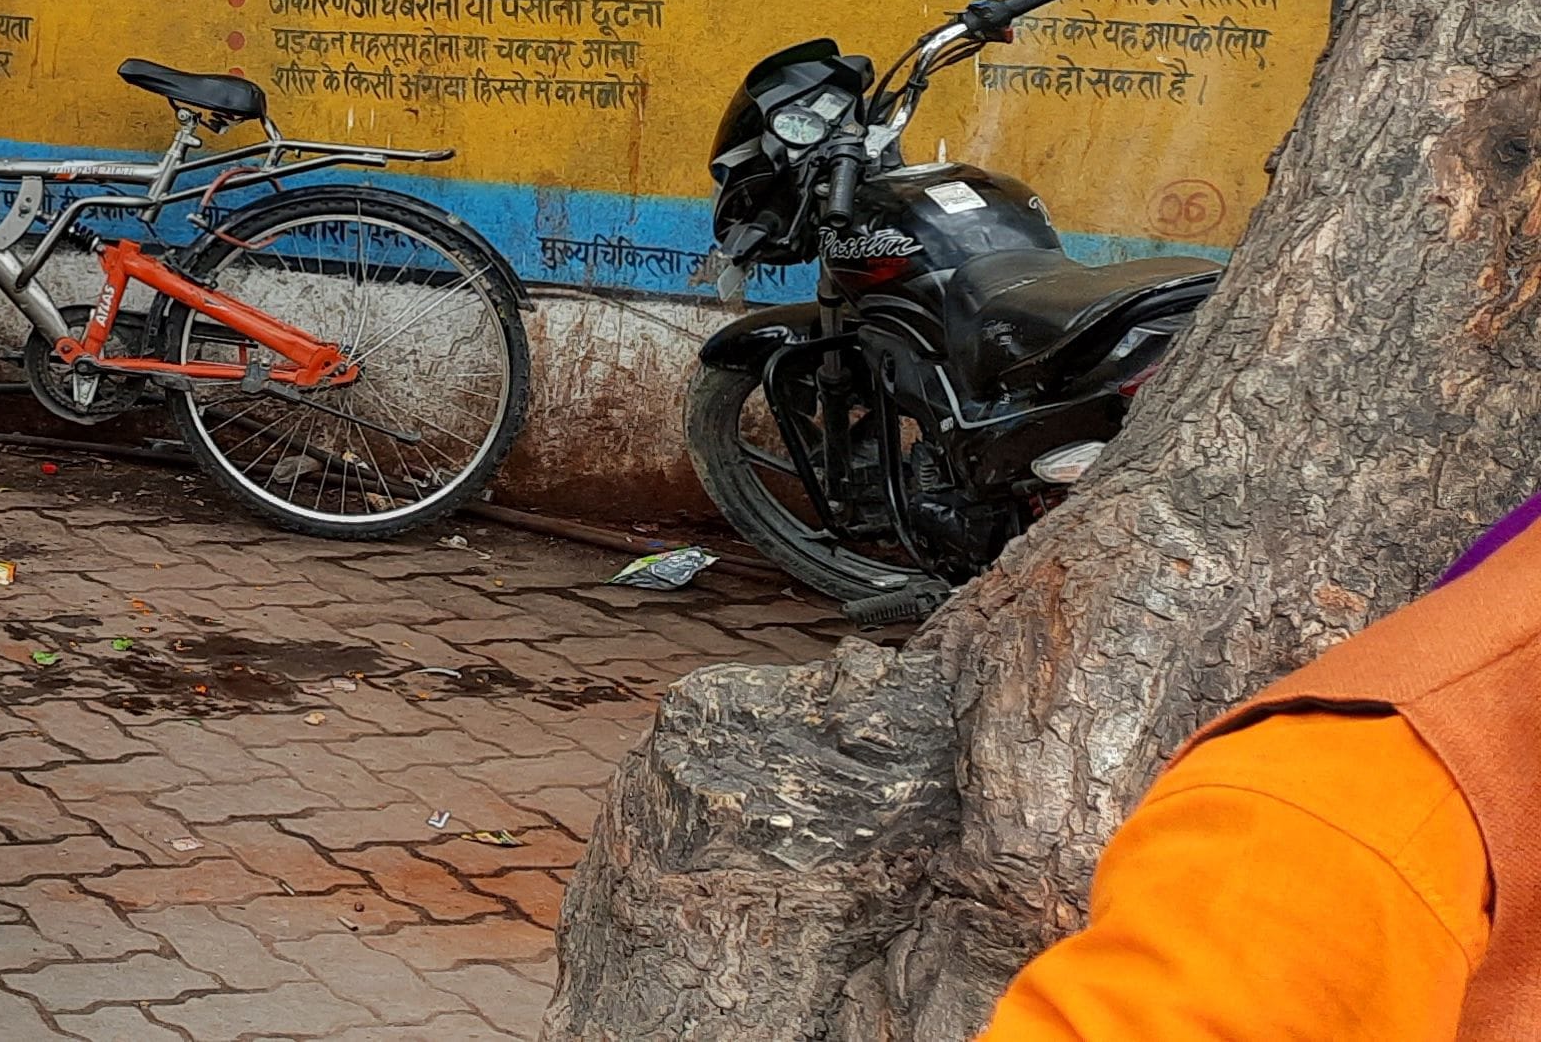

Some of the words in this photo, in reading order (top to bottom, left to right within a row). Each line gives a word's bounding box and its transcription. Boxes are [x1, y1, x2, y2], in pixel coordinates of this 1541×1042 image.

[347, 29, 420, 69] महसूस
[418, 27, 464, 68] होना
[462, 35, 489, 65] या
[492, 36, 575, 70] चक्कर
[1104, 20, 1142, 53] यह
[1141, 14, 1213, 58] आपके
[1211, 14, 1273, 70] लिए
[269, 61, 322, 98] शरीर
[321, 57, 343, 94] के
[342, 59, 399, 101] किसी
[471, 67, 533, 107] हिस्से
[1054, 54, 1087, 100] हो
[1085, 66, 1166, 100] सकता
[1166, 57, 1195, 106] है
[536, 235, 594, 271] मुख्य
[592, 232, 685, 279] चिकित्सा
[818, 225, 924, 261] Passion
[95, 283, 116, 329] ATLAS
